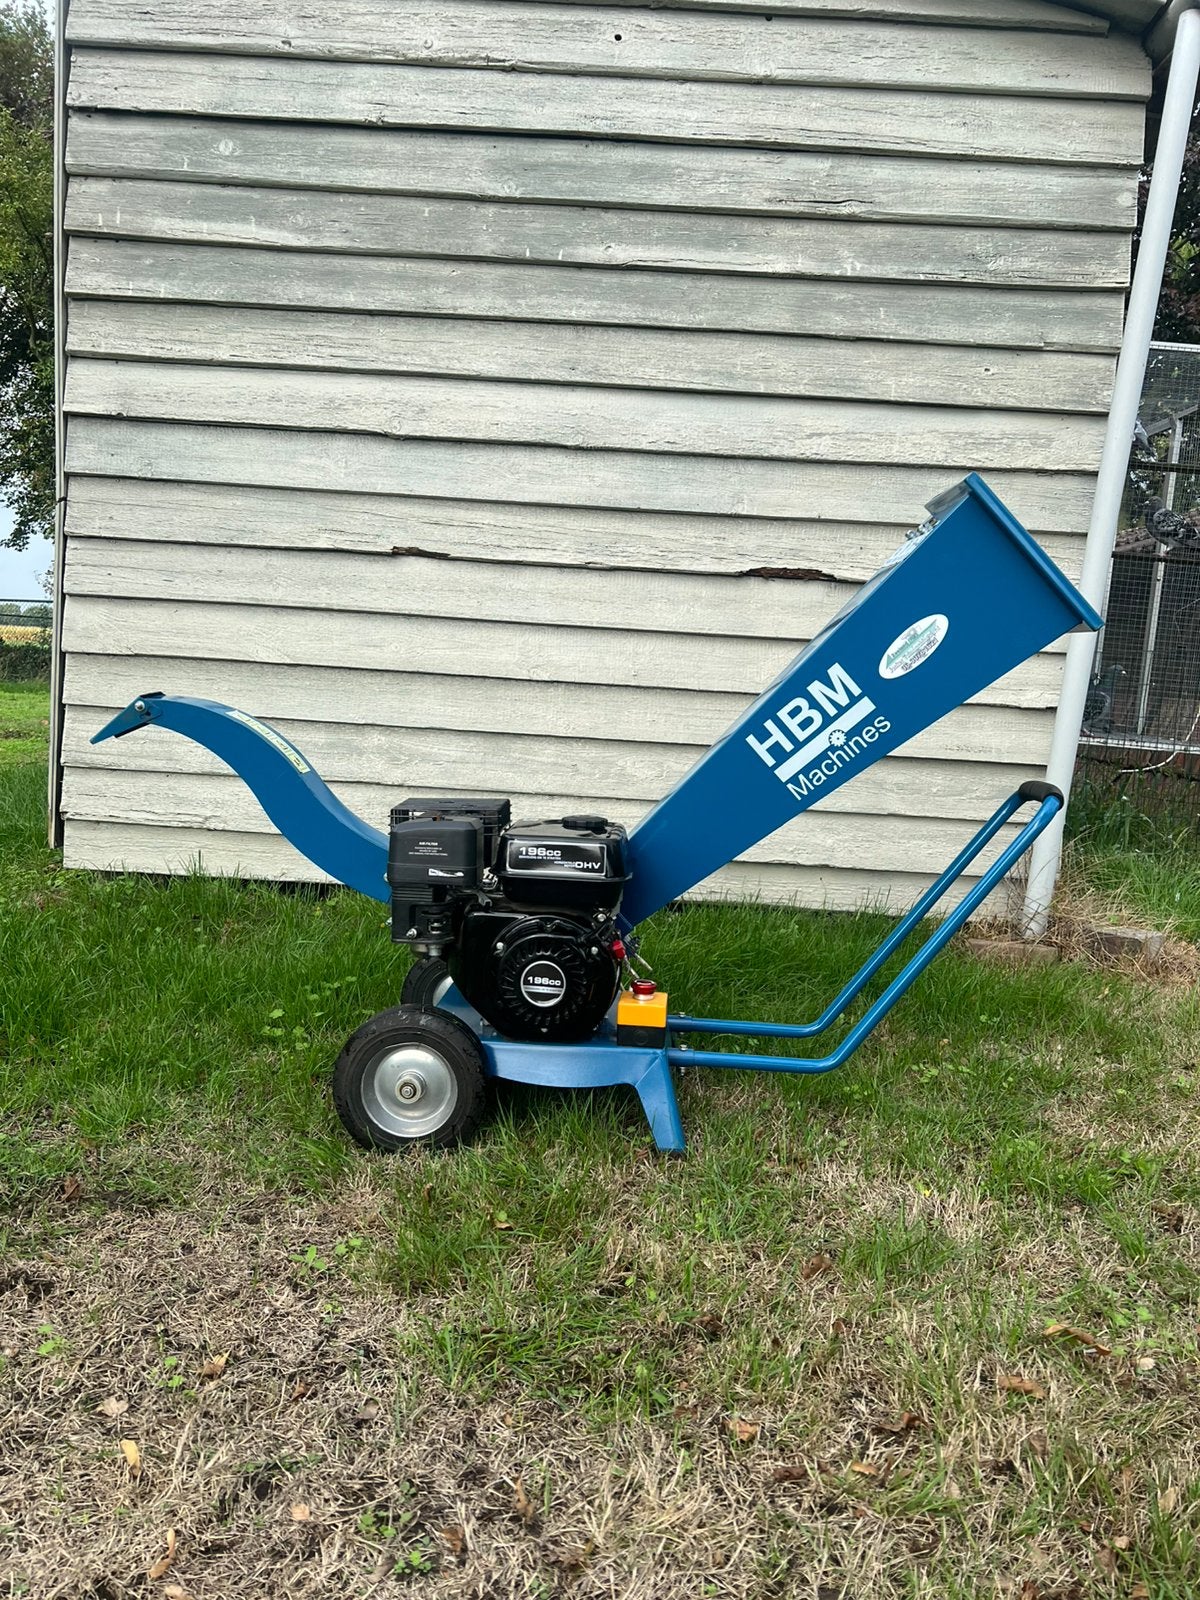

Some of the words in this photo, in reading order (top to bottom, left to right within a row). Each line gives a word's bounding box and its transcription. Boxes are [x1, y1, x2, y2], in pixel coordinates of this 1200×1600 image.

[745, 662, 862, 768] HBM
[786, 715, 891, 801] Machines
[519, 846, 561, 857] 196cc
[575, 861, 601, 870] OHV
[527, 976, 562, 986] 196cc
